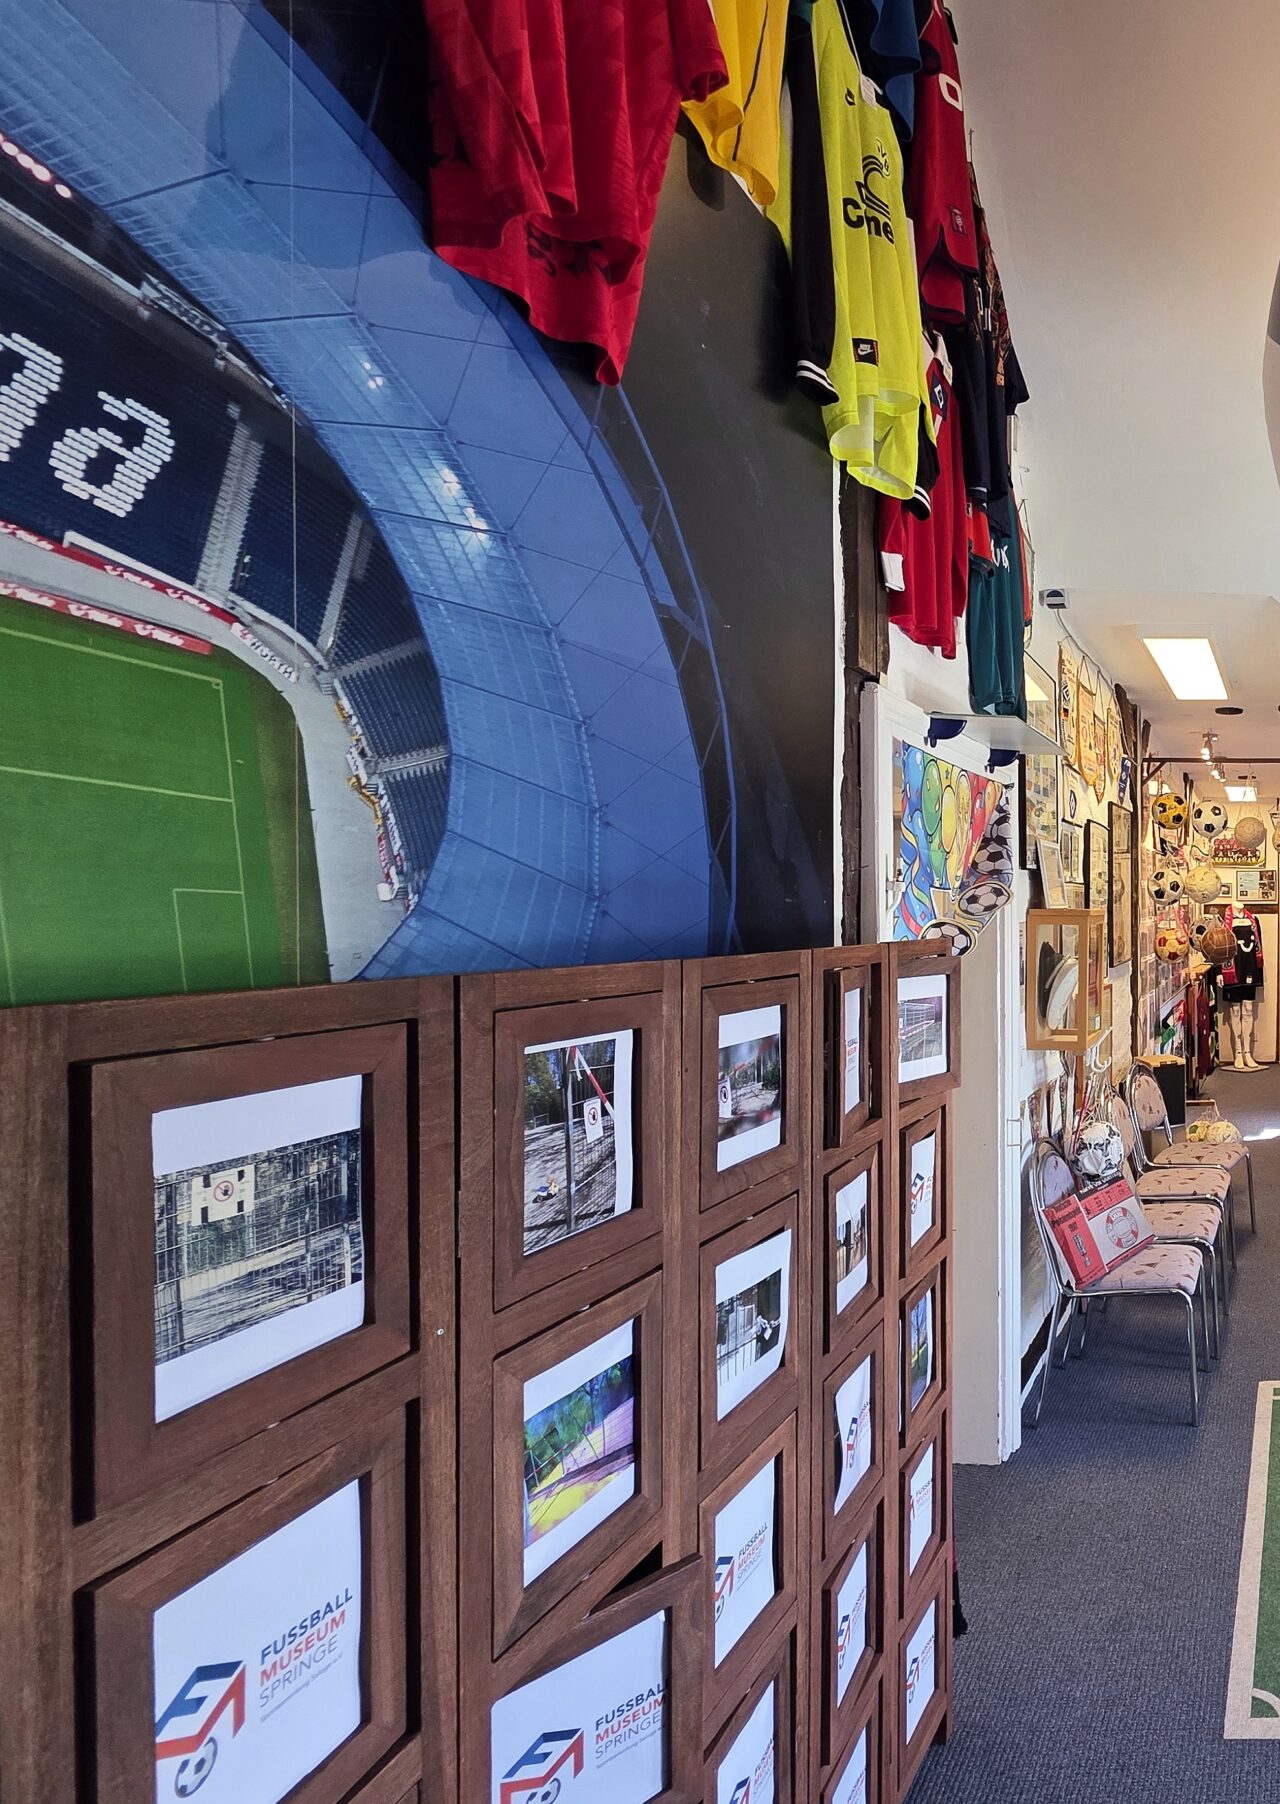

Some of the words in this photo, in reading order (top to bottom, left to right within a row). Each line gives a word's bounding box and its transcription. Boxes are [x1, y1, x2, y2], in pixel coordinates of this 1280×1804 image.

[259, 1609, 346, 1688] MUSEUM
[260, 1587, 353, 1667] FUSSBALL
[259, 1634, 338, 1709] SPRINGE
[595, 1711, 661, 1760] SPRINGE
